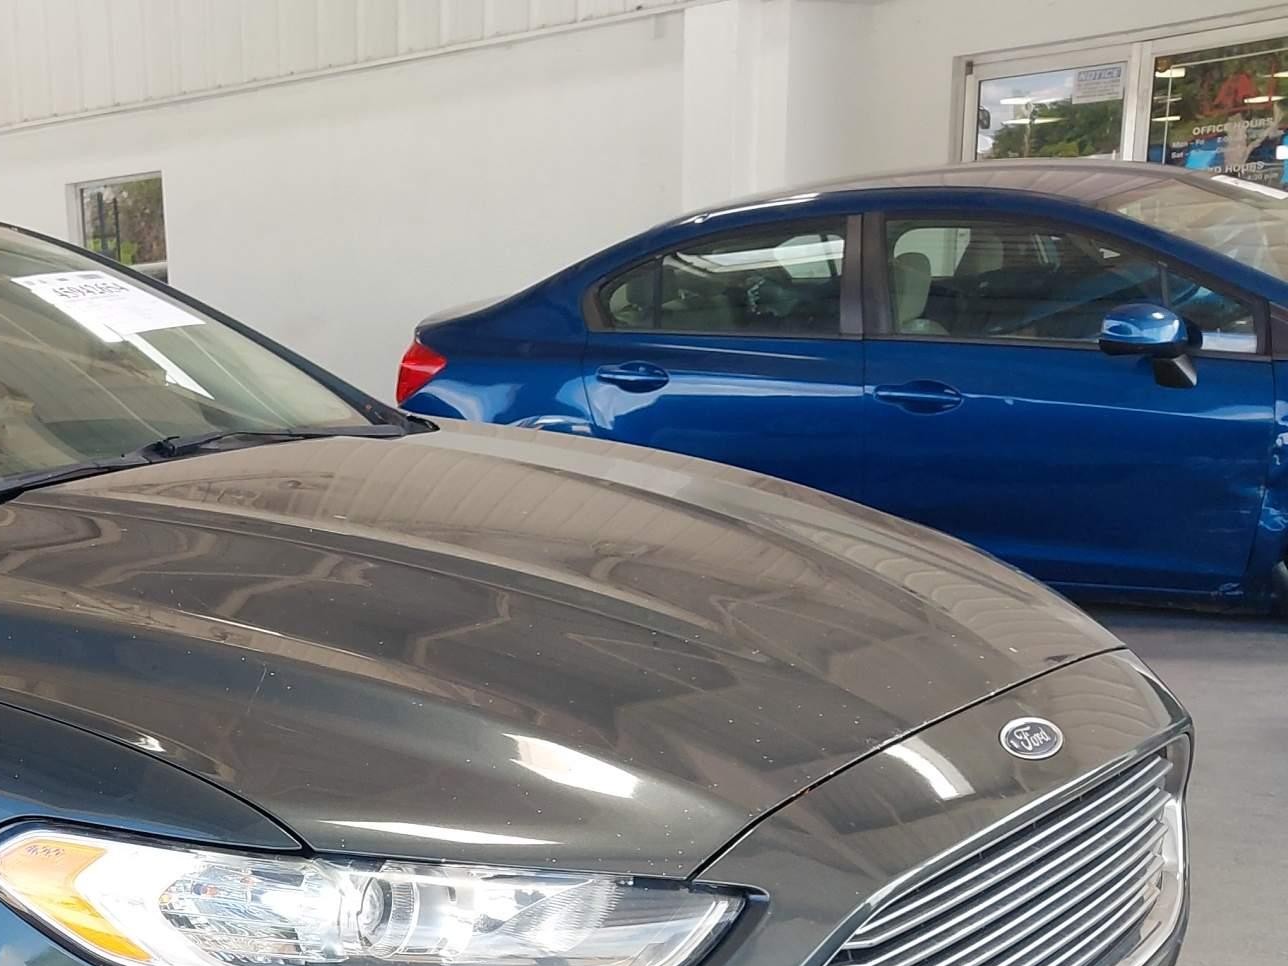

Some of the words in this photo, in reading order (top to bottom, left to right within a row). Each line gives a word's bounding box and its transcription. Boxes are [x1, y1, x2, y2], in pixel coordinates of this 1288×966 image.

[1078, 69, 1120, 80] NOTICE
[1234, 118, 1273, 129] HOURS
[1014, 726, 1051, 751] Ford
